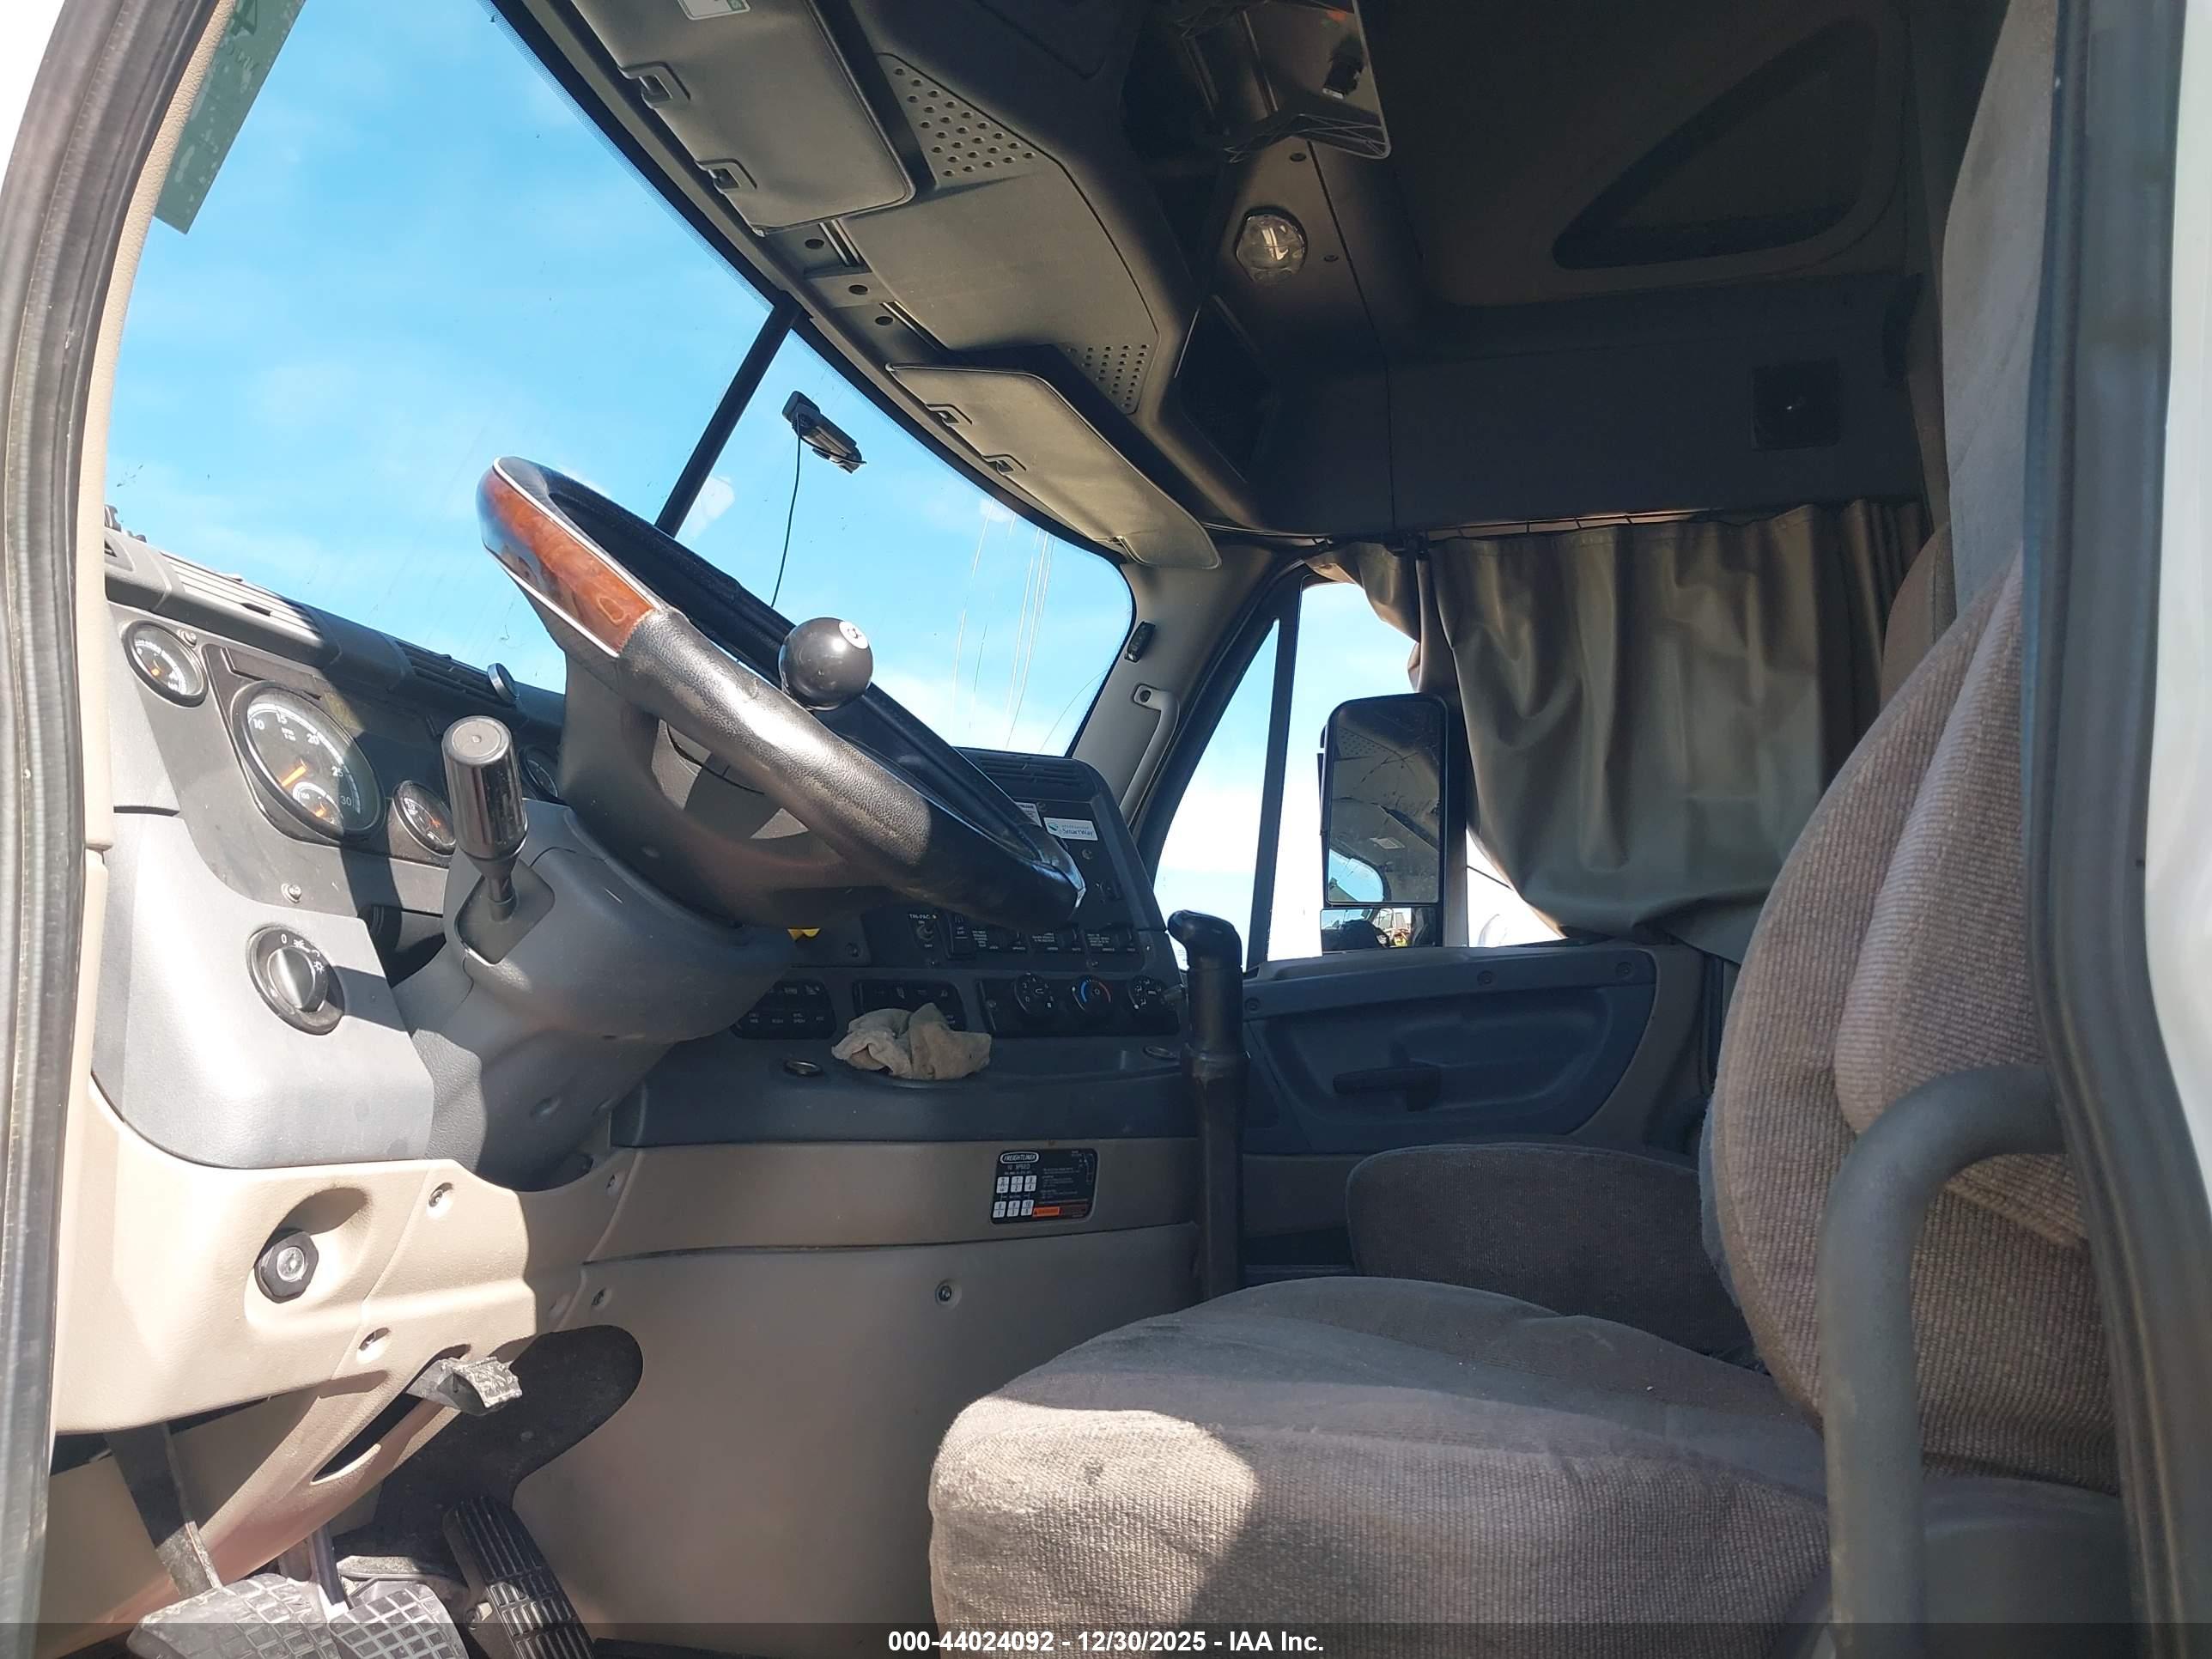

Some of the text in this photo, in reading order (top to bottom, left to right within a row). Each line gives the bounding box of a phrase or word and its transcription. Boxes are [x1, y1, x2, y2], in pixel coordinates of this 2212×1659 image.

[252, 718, 265, 730] 10
[276, 713, 288, 725] 15
[306, 732, 320, 745] 20
[331, 765, 344, 778] 25
[339, 794, 352, 806] 30
[1003, 1153, 1036, 1162] FREIGHTLINER
